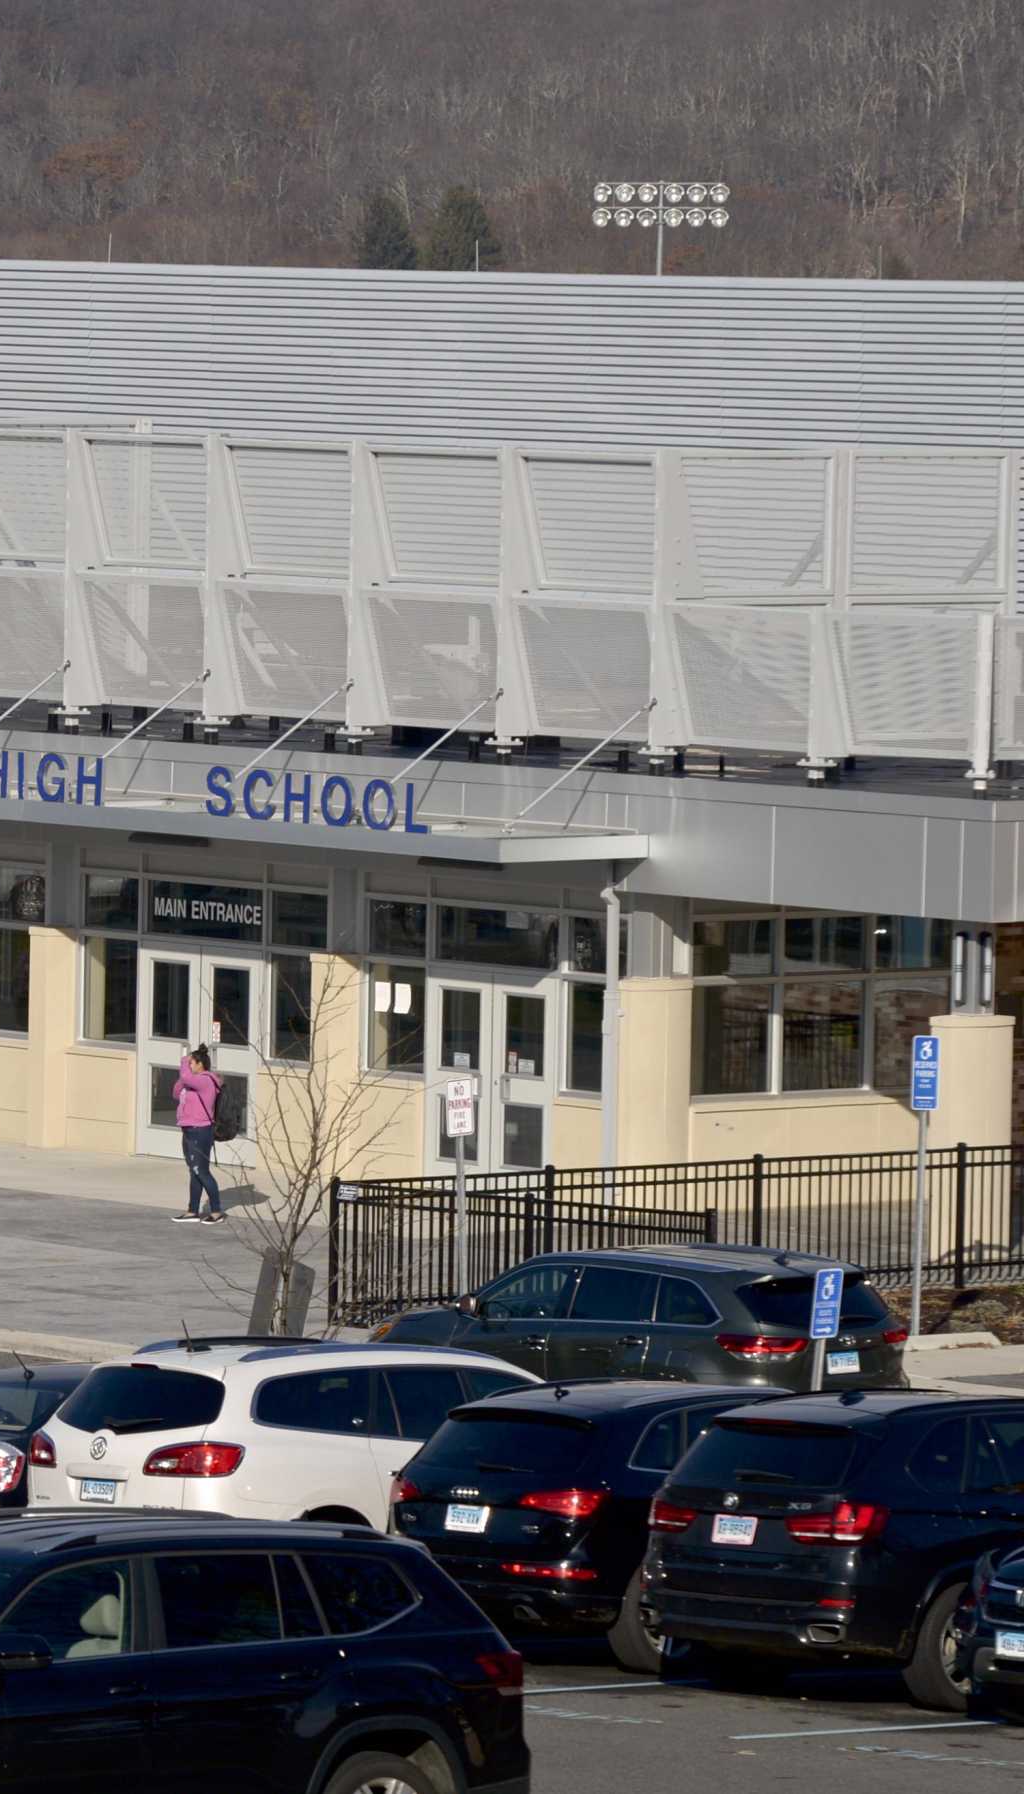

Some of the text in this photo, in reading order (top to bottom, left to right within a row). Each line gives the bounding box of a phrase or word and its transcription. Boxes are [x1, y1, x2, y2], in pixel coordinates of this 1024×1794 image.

[207, 766, 429, 834] SCHOOL
[154, 897, 262, 925] MAIN ENTRANCE
[454, 1085, 465, 1096] NO
[448, 1098, 471, 1110] PARKING
